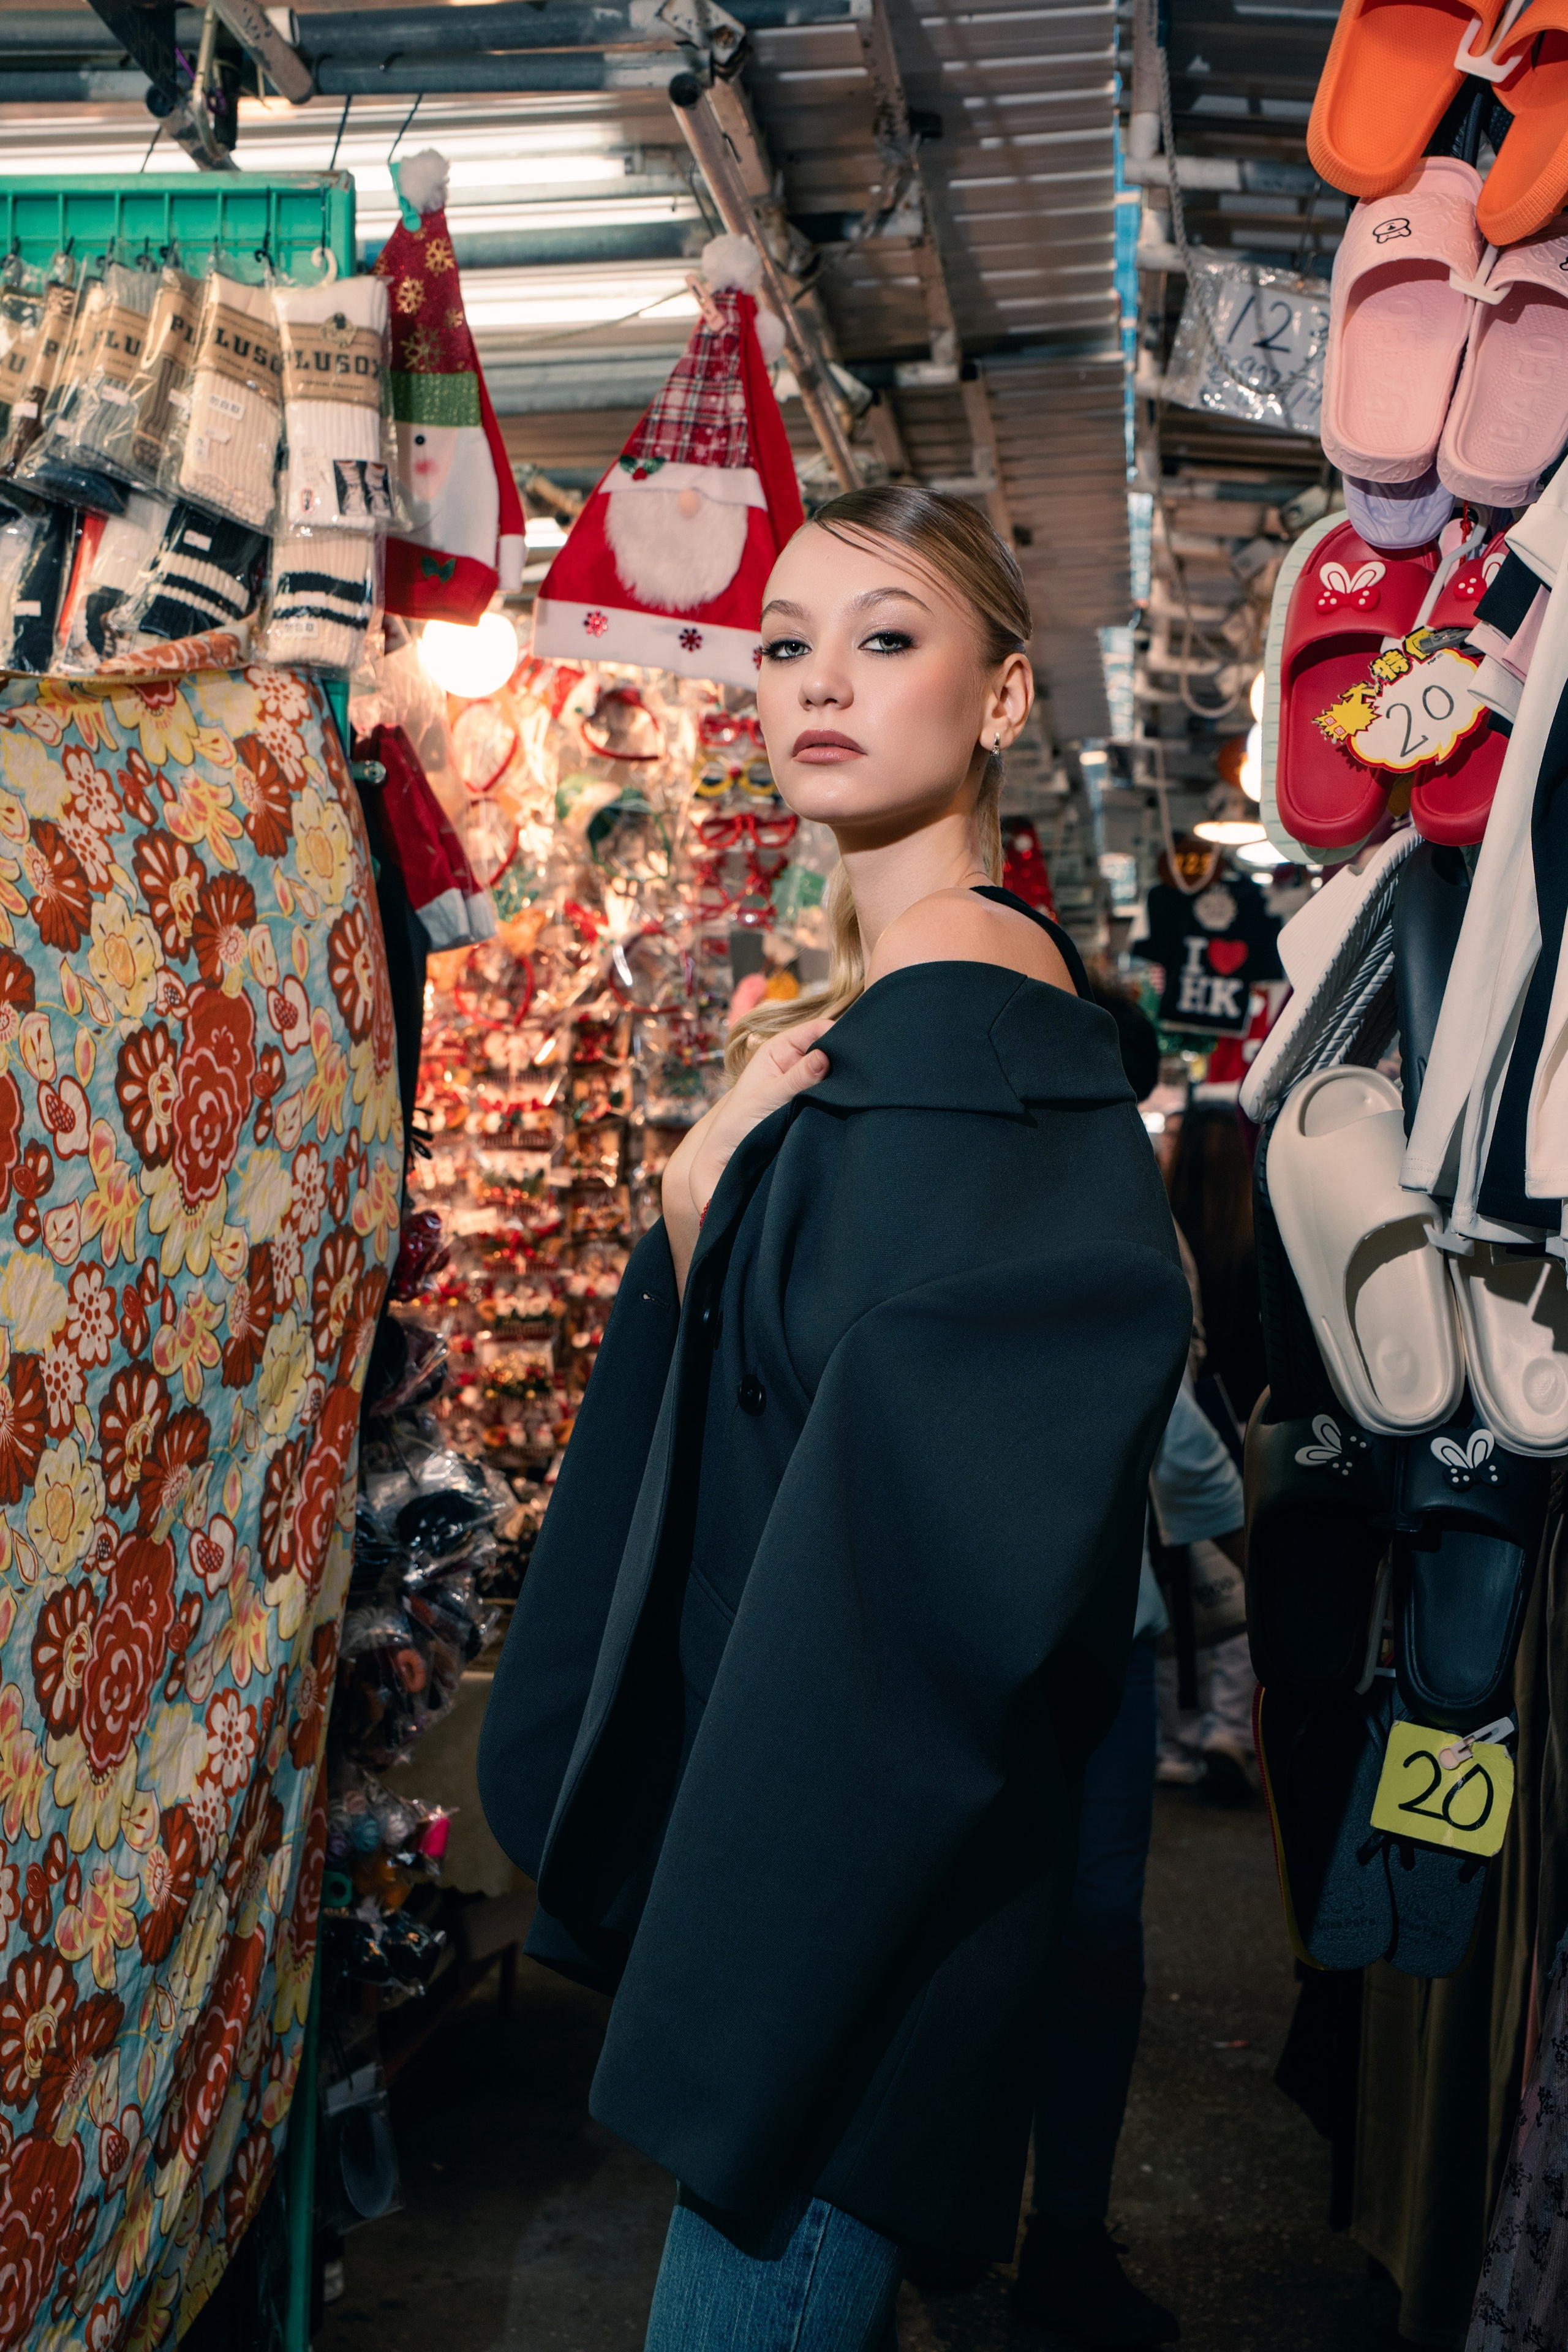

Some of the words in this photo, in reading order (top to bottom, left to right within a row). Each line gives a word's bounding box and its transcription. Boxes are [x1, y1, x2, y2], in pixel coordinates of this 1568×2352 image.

[1227, 295, 1291, 353] 12
[1386, 685, 1455, 758] 20
[1177, 974, 1243, 1019] HK
[1398, 1750, 1494, 1831] 20
